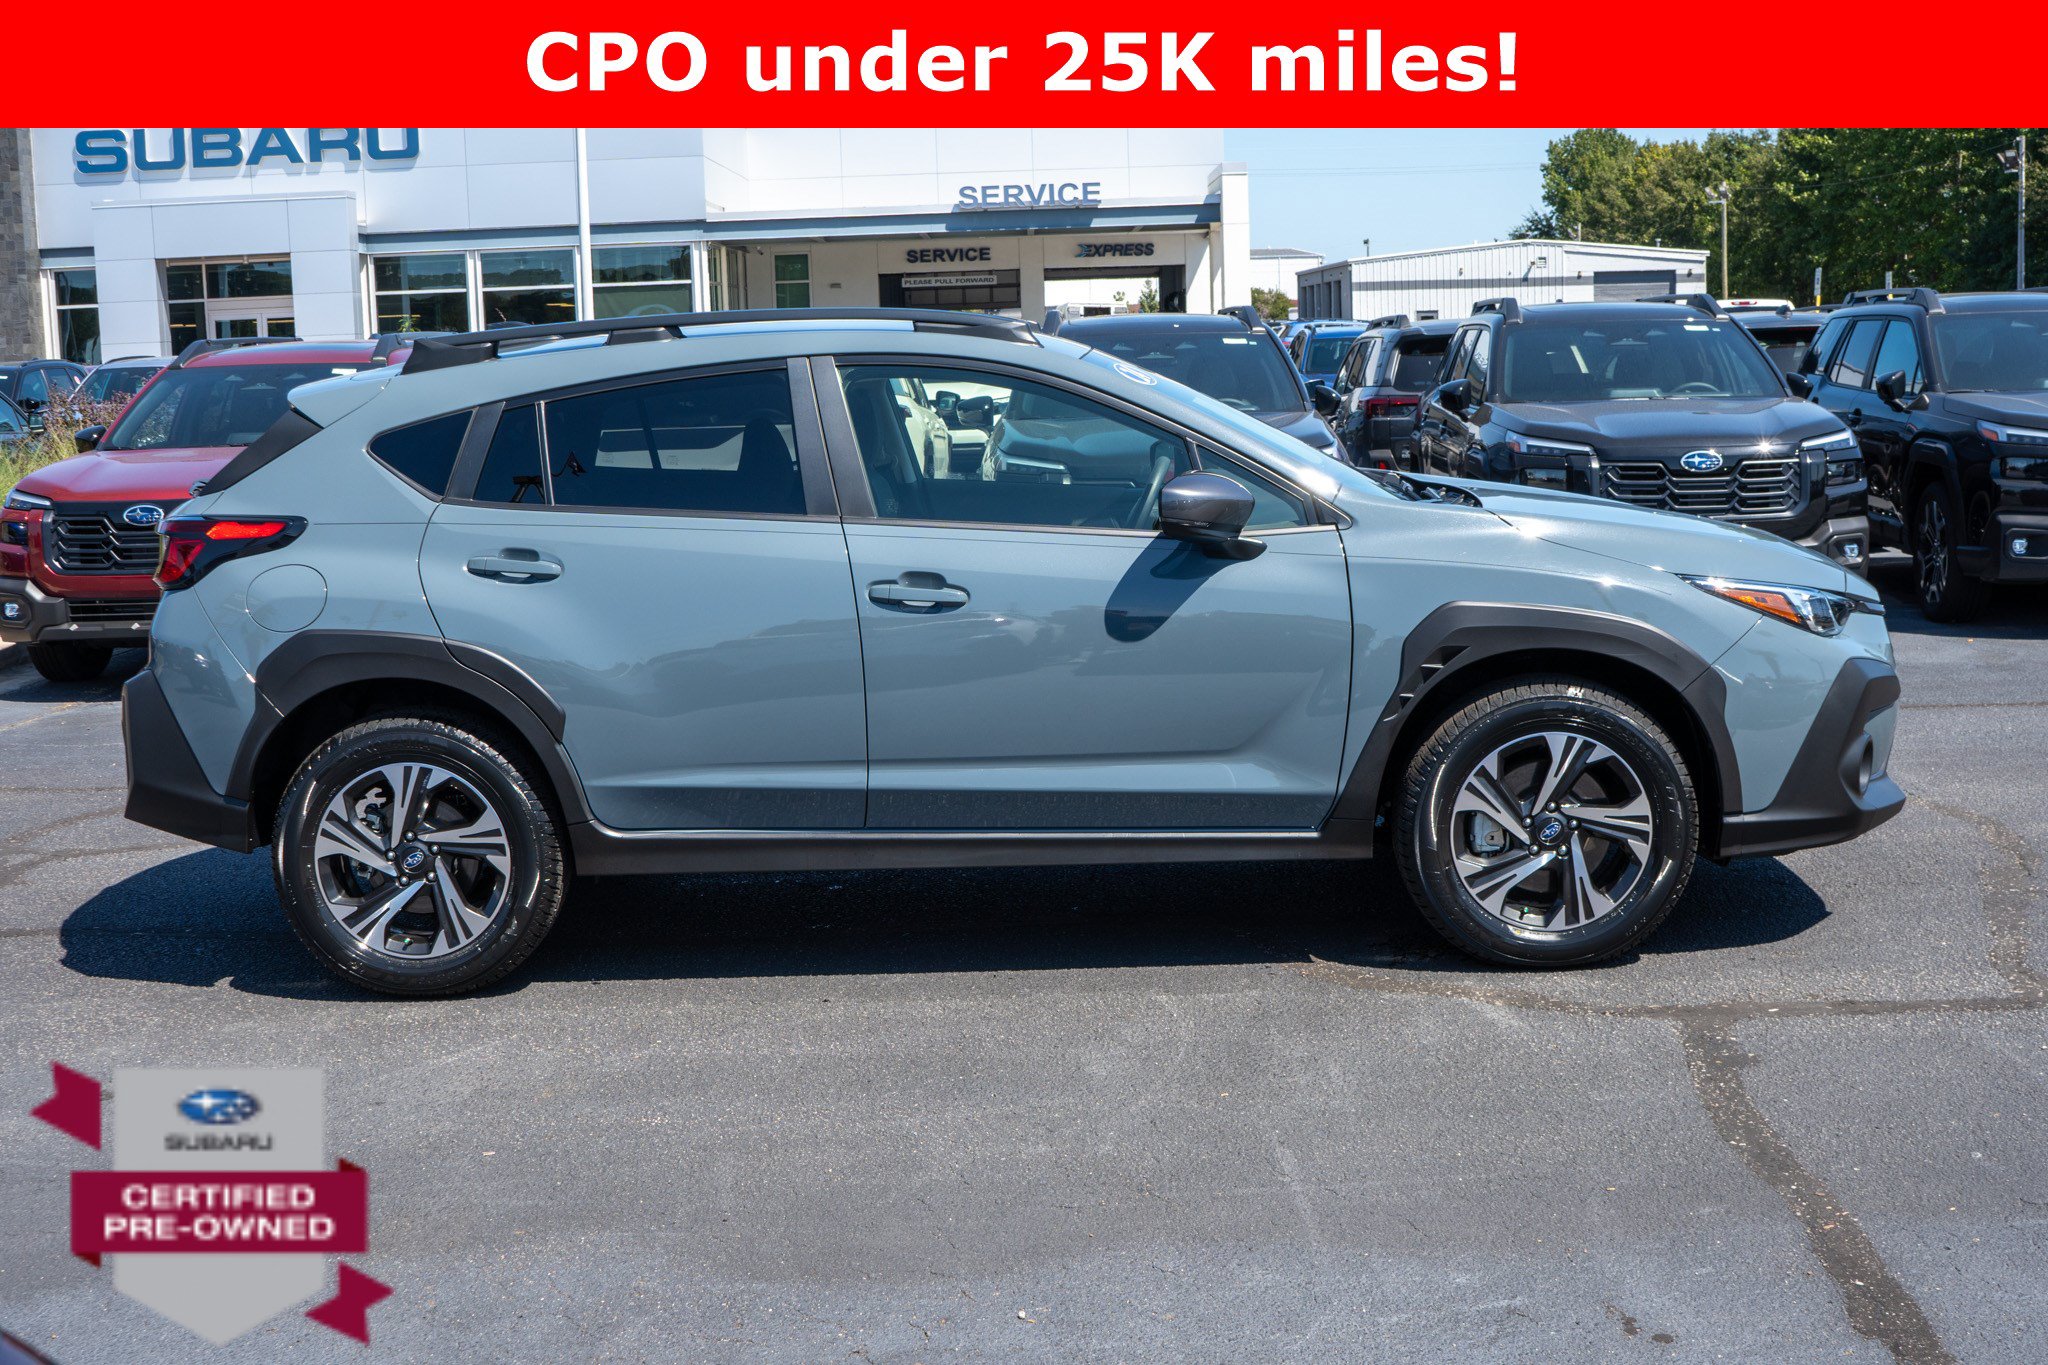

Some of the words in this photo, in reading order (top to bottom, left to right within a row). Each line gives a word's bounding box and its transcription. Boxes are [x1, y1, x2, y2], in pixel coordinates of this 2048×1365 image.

[74, 128, 420, 174] SUBARU
[958, 182, 1102, 209] SERVICE
[906, 247, 991, 264] SERVICE
[1075, 243, 1155, 258] EXPRESS
[904, 278, 933, 286] PLEASE
[955, 276, 994, 284] FORWARD
